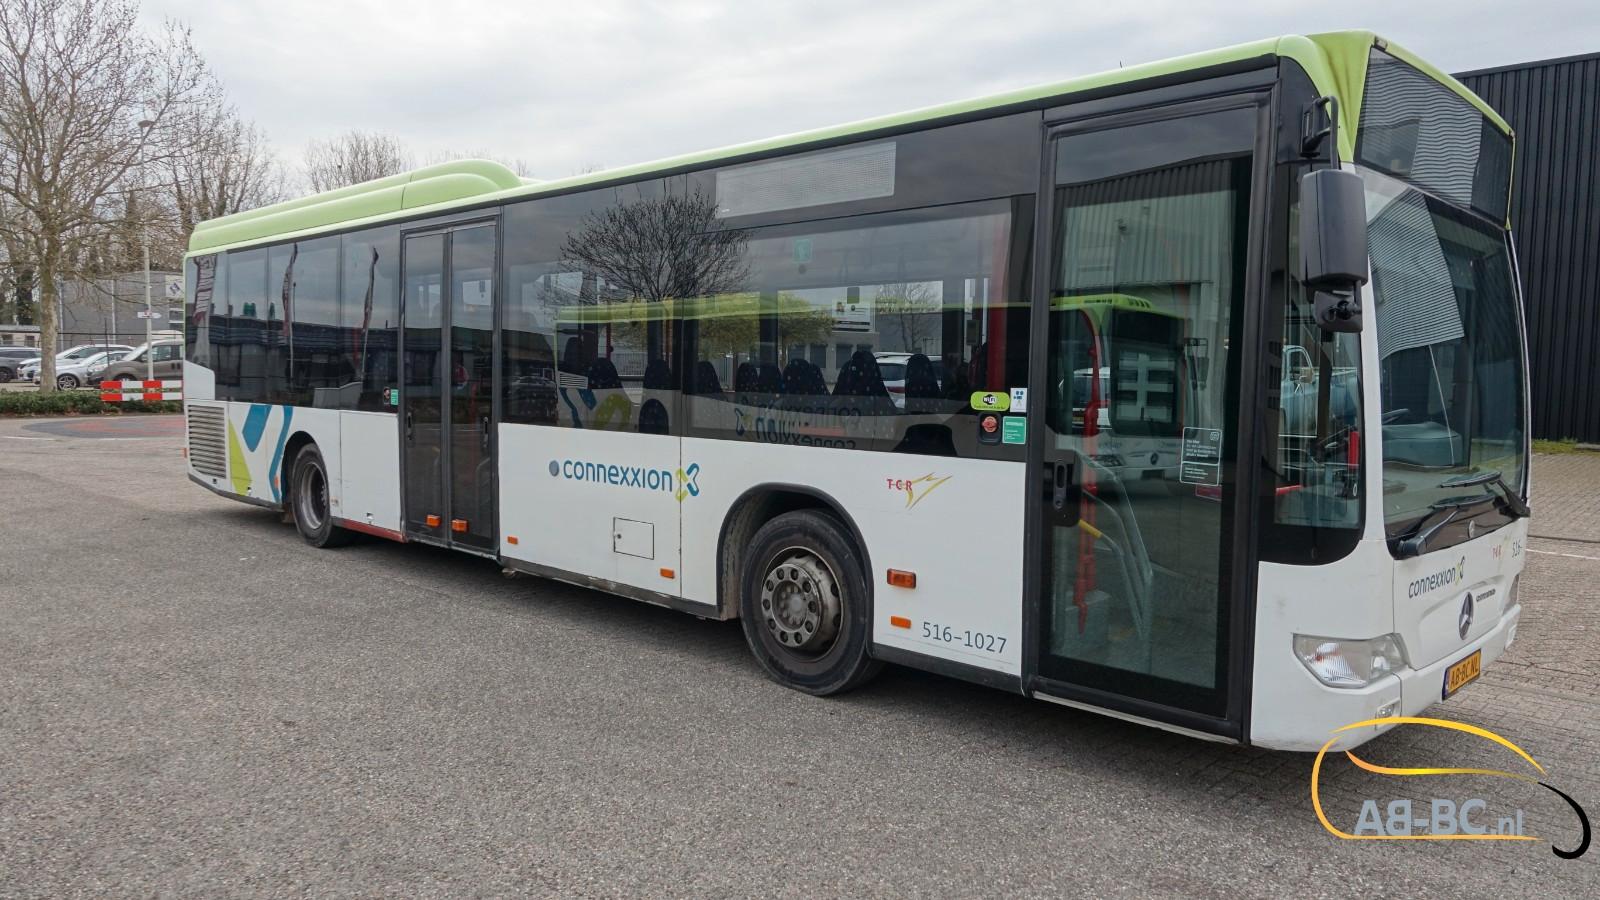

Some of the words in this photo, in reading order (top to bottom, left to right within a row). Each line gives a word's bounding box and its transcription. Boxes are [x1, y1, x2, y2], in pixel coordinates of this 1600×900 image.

[563, 460, 673, 492] connexxion
[887, 478, 913, 491] TCR
[1408, 567, 1456, 599] connexxion
[922, 621, 1007, 654] 516-1027
